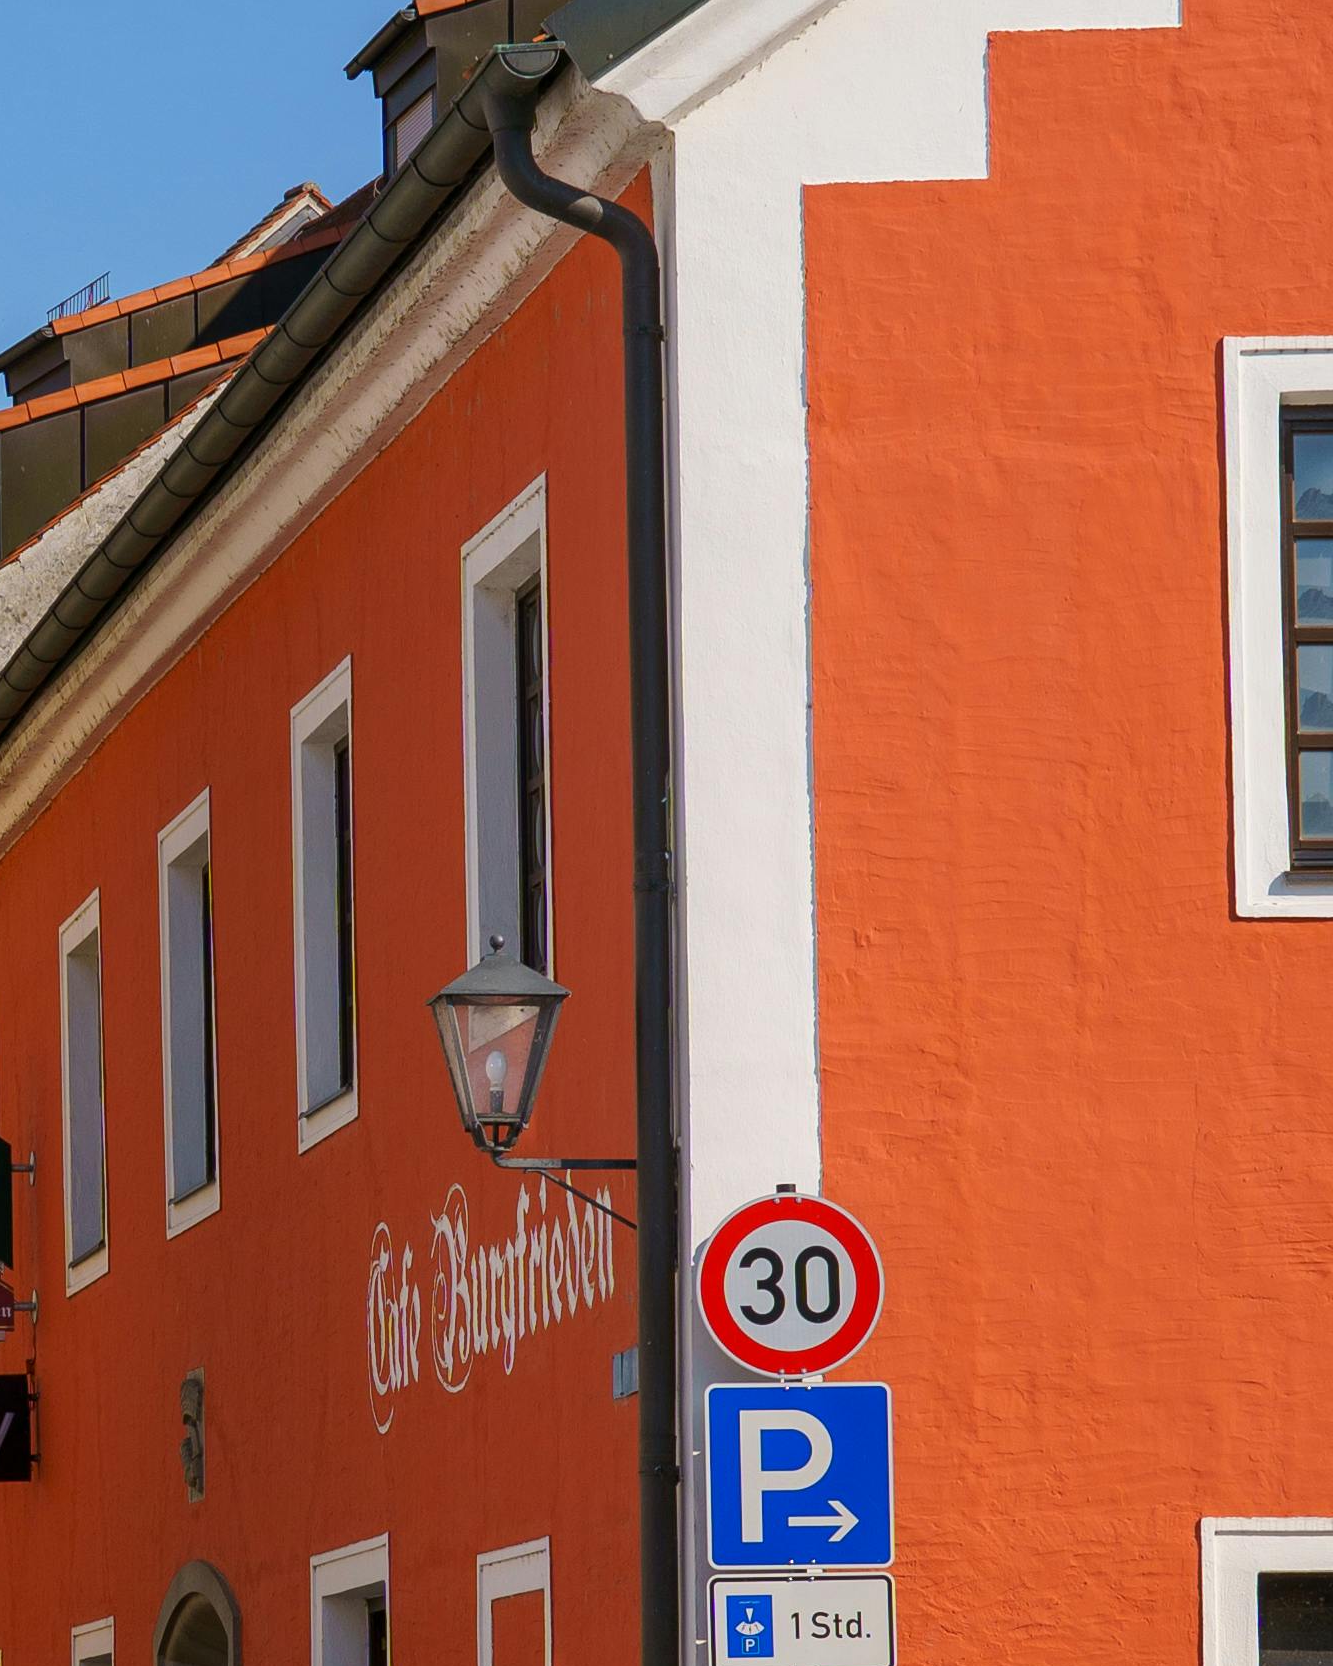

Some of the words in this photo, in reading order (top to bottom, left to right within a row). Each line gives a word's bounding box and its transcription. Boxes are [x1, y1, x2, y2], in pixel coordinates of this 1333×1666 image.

[430, 1168, 615, 1393] Burgfrieden
[739, 1245, 841, 1326] 30
[739, 1409, 833, 1543] P
[791, 1611, 800, 1639] 1
[811, 1611, 871, 1639] Std.
